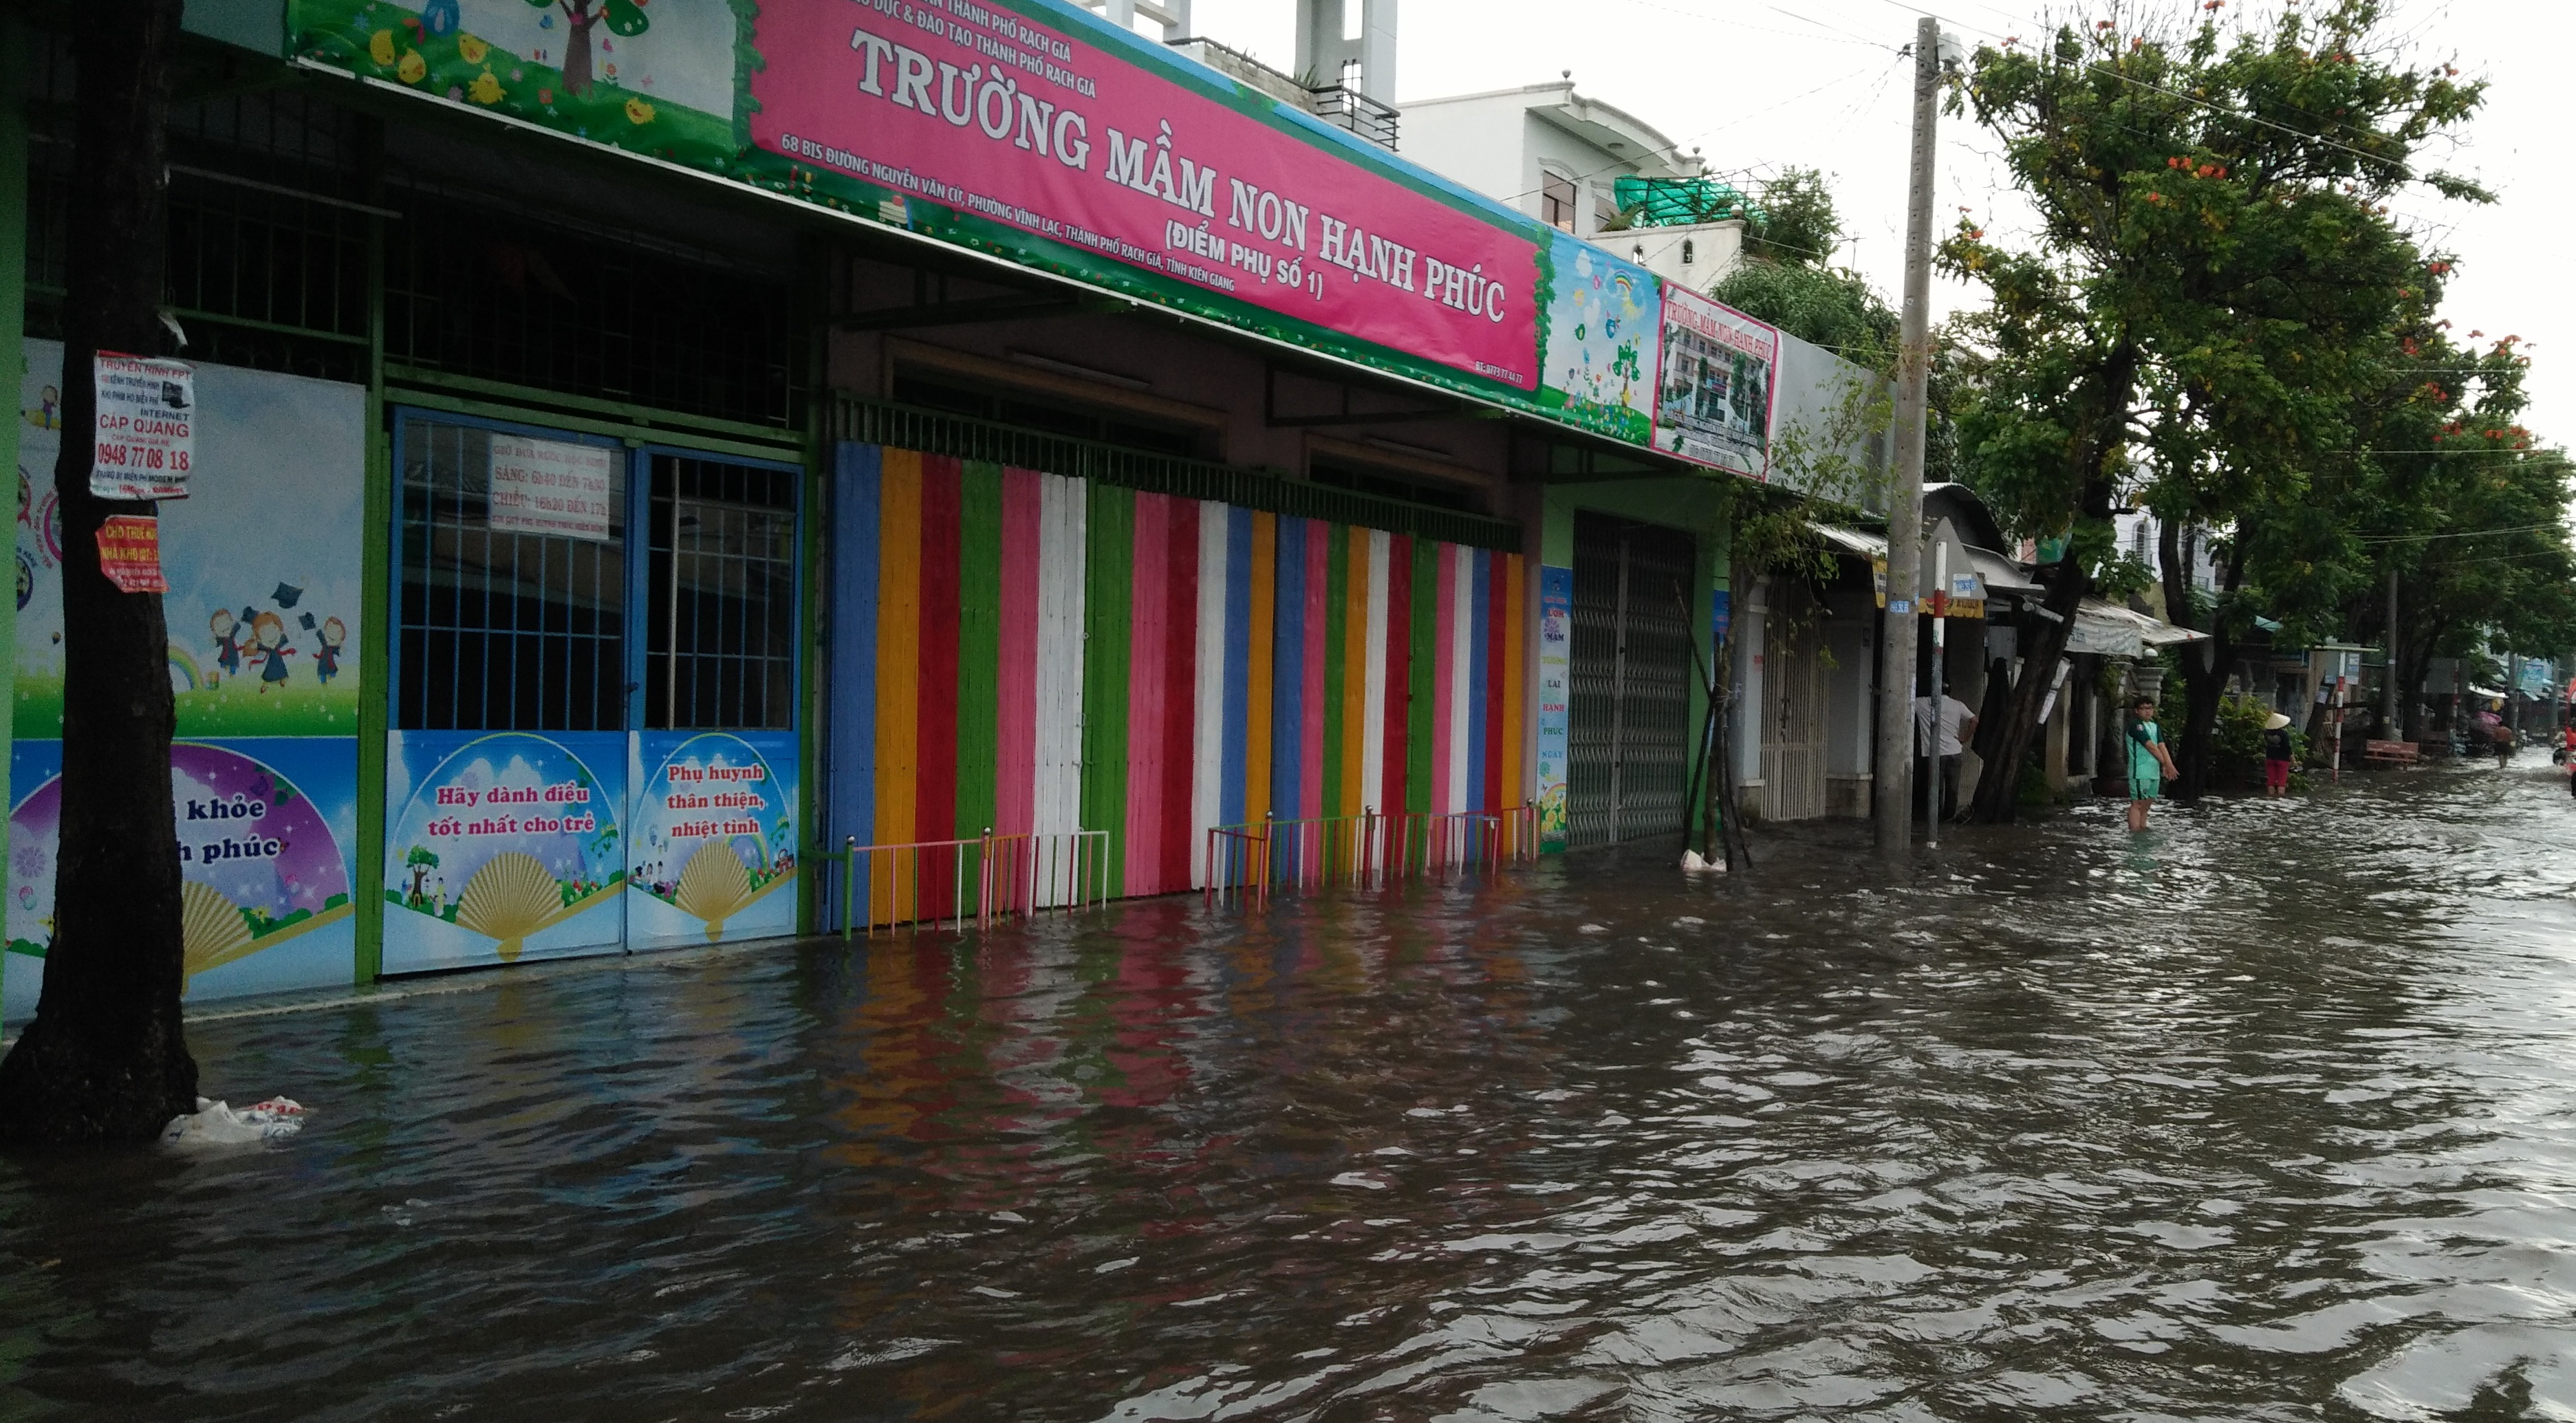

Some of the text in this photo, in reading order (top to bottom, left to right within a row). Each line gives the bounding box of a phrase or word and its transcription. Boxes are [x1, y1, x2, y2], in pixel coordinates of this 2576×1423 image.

[903, 4, 915, 25] &
[917, 10, 945, 36] ĐÀO
[947, 21, 973, 47] TẠO
[975, 34, 1018, 66] THÀNH
[1019, 54, 1045, 76] PHỐ
[1046, 61, 1075, 91] RẠCH
[1076, 78, 1096, 99] GIÁ
[993, 17, 1018, 39] PHỐ
[1020, 27, 1050, 53] RẠCH
[1051, 41, 1072, 63] GIÁ
[850, 29, 1506, 323] TRƯỜNG MẦM NON HẠNH PHÚC
[781, 133, 799, 153] 68
[802, 140, 823, 160] BIS
[825, 146, 869, 175] ĐƯỜNG
[872, 162, 920, 191] NGUYỄN
[921, 177, 945, 199] VĂN
[968, 193, 1013, 219] PHƯỜNG
[1015, 207, 1040, 229] VĨNH
[1041, 217, 1063, 238] LẠC,
[1065, 224, 1098, 248] THÀNH
[1100, 236, 1121, 255] PHỐ
[1121, 243, 1145, 263] RẠCH
[1166, 257, 1187, 276] TỈNH
[1188, 265, 1209, 284] KIÊN
[1209, 272, 1235, 292] GIANG
[1165, 218, 1323, 301] (ĐIỂM PHỤ SỐ 1)
[172, 369, 191, 380] FPT
[100, 412, 189, 437] CÁP QUANG
[98, 442, 127, 466] 0948
[170, 450, 188, 470] 18
[1548, 680, 1561, 688] LAI
[669, 764, 764, 783] Phụ huynh
[437, 782, 588, 807] Hãy dành điều
[668, 791, 764, 810] thân thiện,
[187, 795, 265, 820] khỏe
[429, 812, 594, 836] tốt nhất cho trẻ
[671, 818, 759, 839] nhiệt tình
[202, 836, 278, 865] phúc
